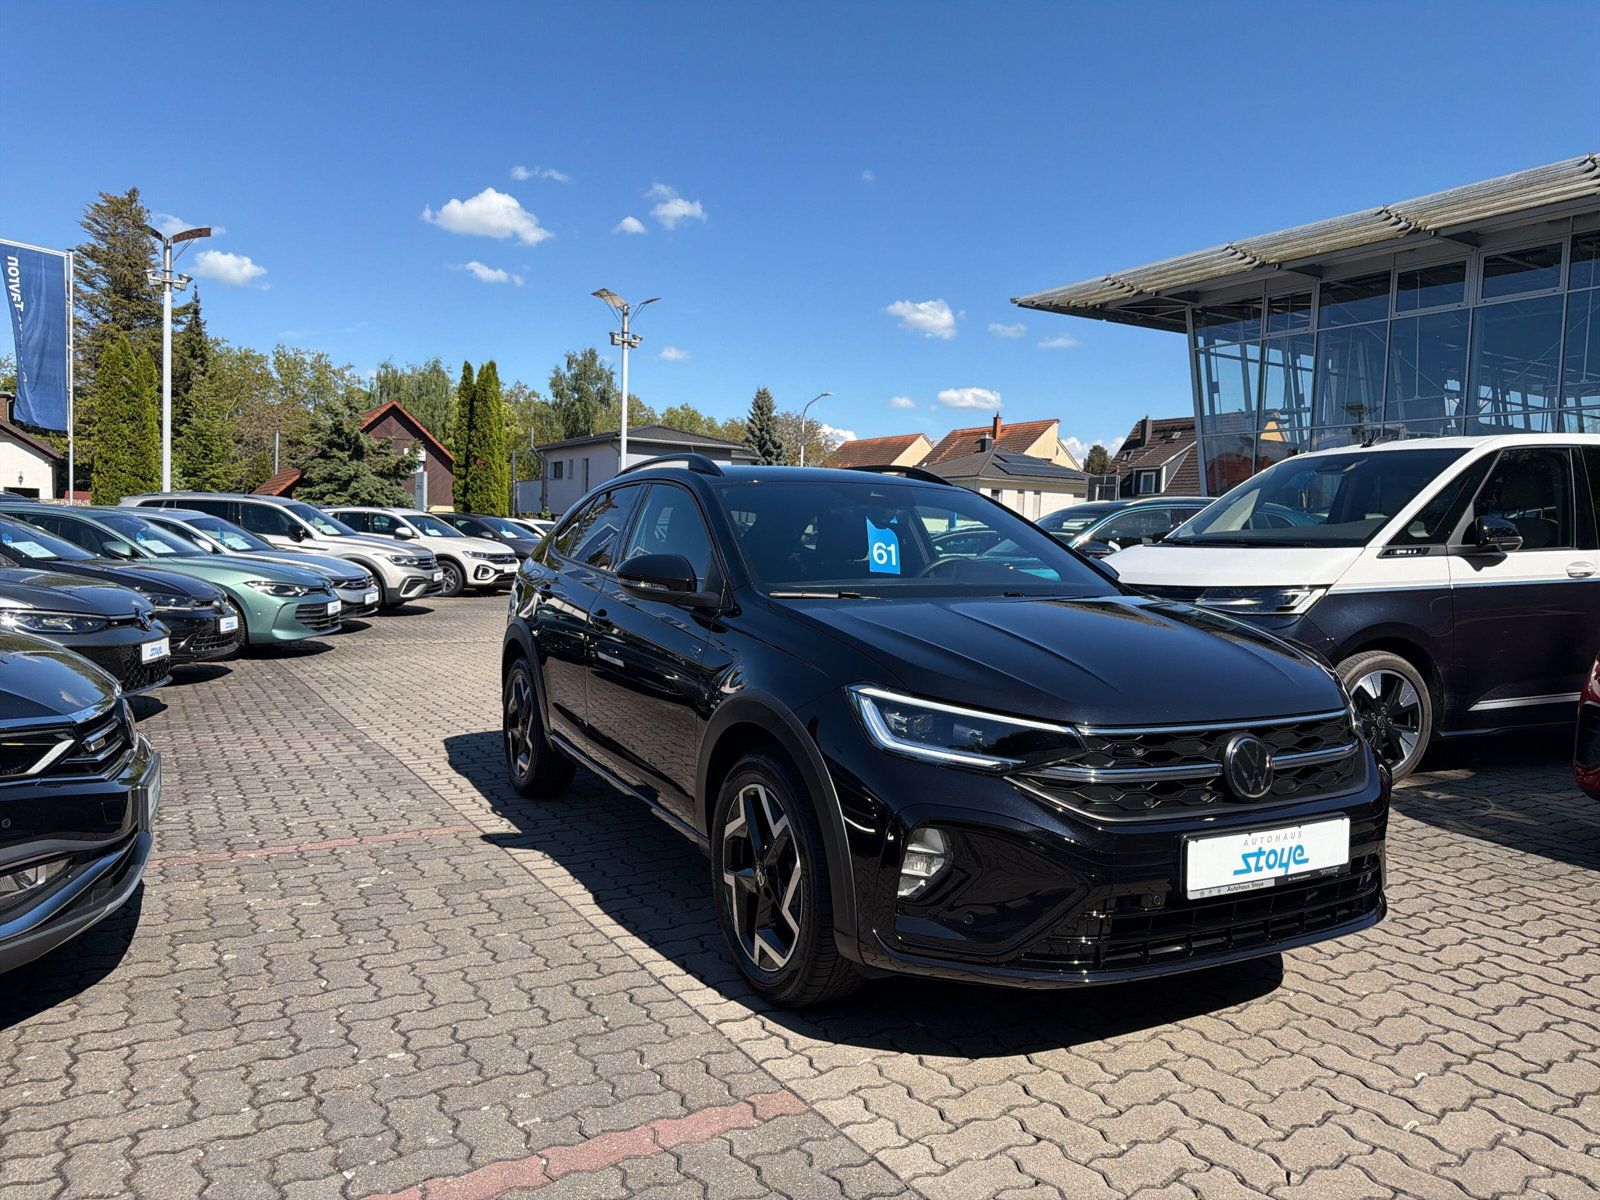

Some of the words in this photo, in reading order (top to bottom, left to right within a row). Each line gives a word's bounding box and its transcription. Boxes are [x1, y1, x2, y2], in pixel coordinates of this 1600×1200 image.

[872, 541, 897, 566] 61
[1243, 830, 1303, 847] AUTOHAUS
[1226, 883, 1250, 893] Autohaus
